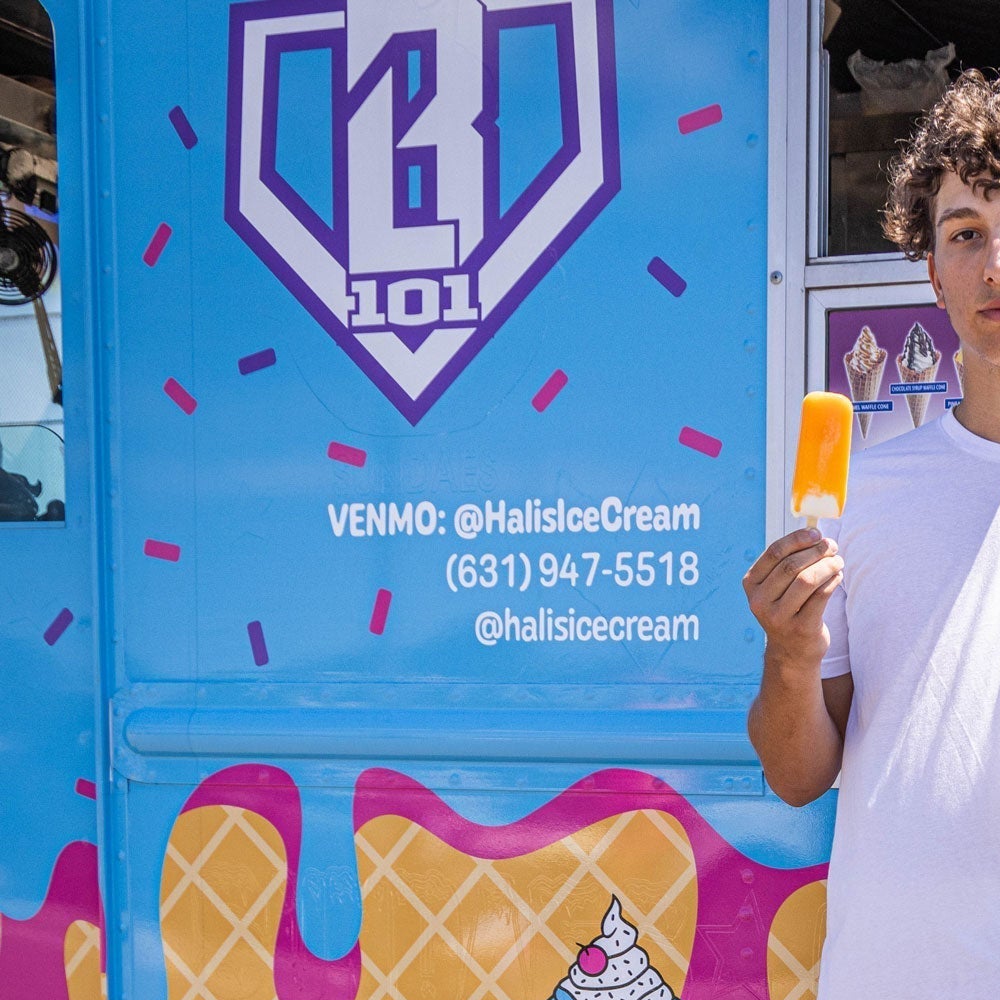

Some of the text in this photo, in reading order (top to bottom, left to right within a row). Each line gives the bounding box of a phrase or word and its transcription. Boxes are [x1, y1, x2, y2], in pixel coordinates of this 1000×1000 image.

[349, 277, 480, 327] 101
[328, 496, 700, 539] VENMO: @HalisIceCream
[446, 551, 699, 592] (631) 947-5518
[475, 607, 699, 646] @halisicecream
